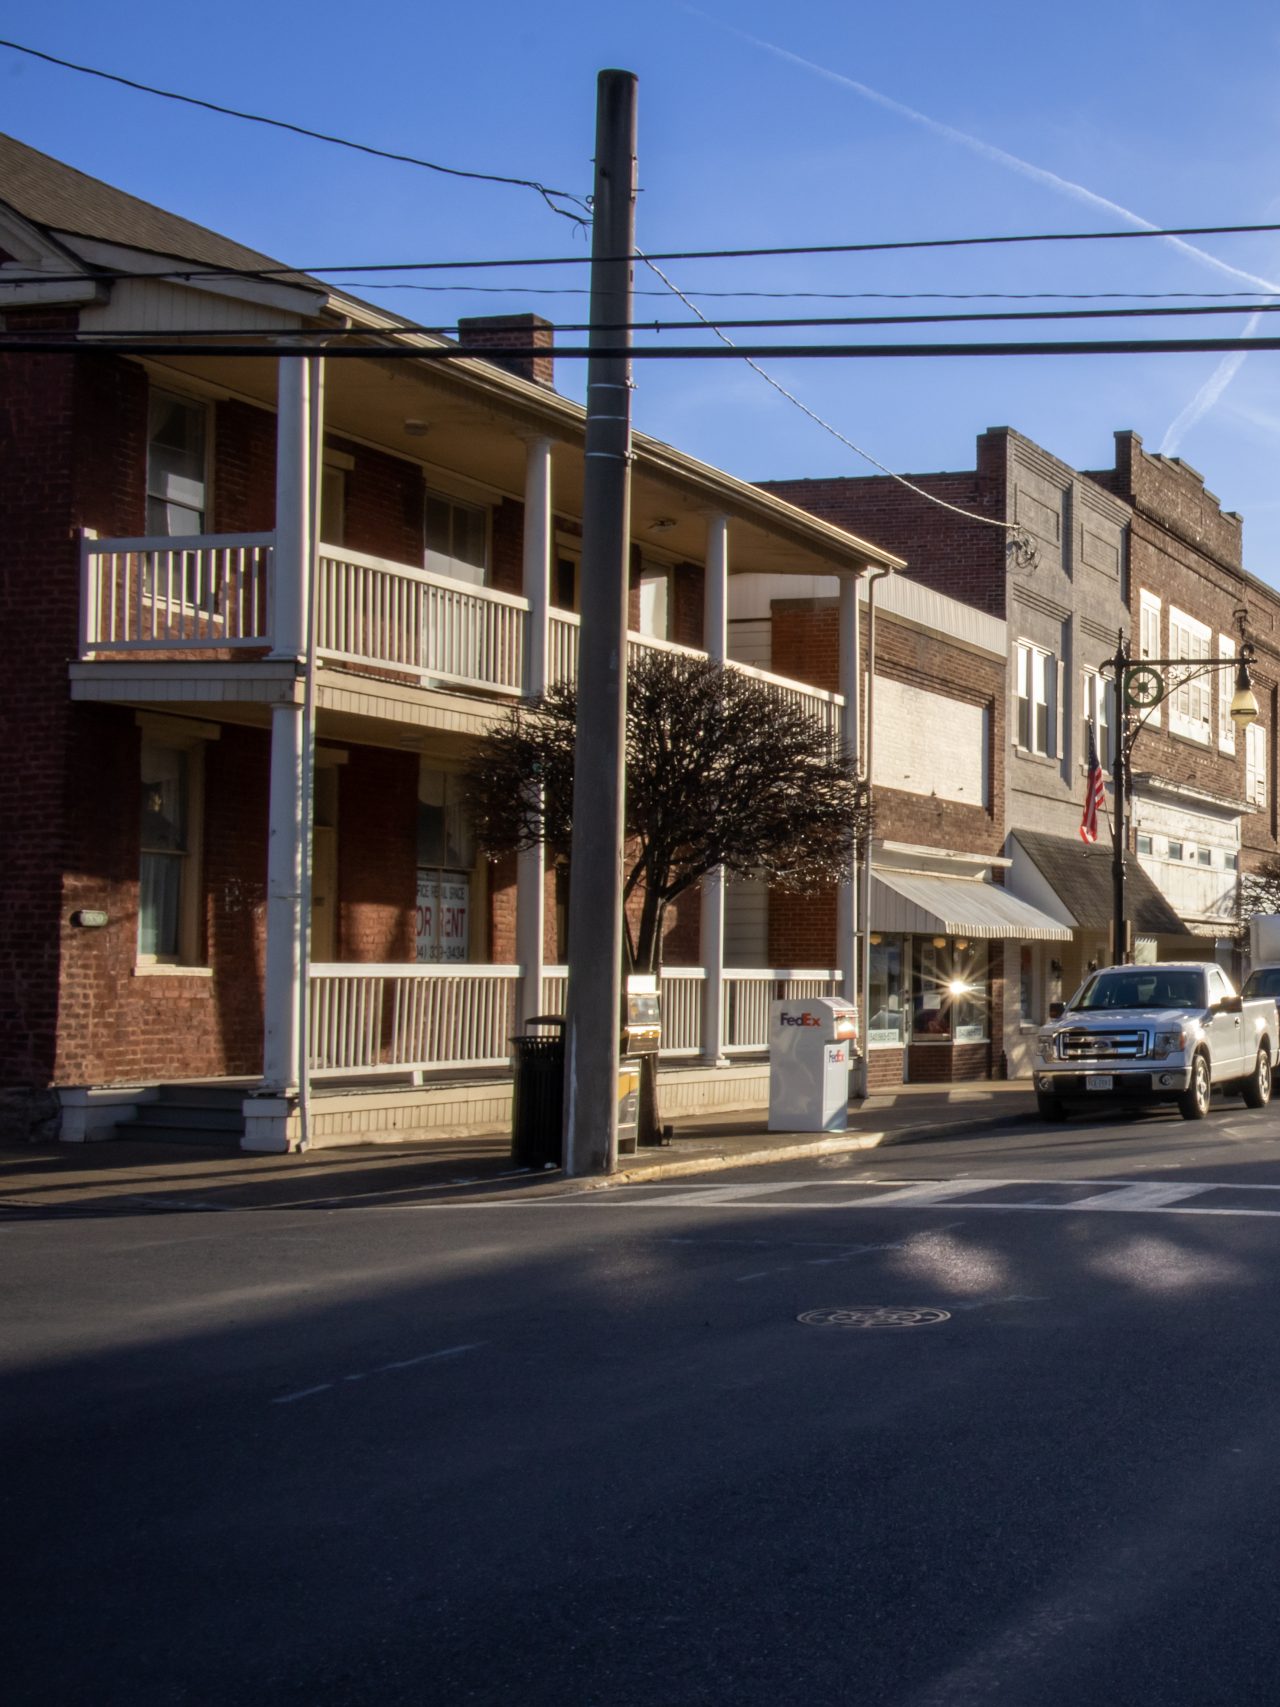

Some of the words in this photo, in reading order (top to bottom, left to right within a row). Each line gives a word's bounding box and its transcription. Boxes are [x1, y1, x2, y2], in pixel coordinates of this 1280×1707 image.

[416, 905, 432, 937] OR
[780, 1012, 821, 1027] FedEx
[828, 1048, 845, 1063] FedEx
